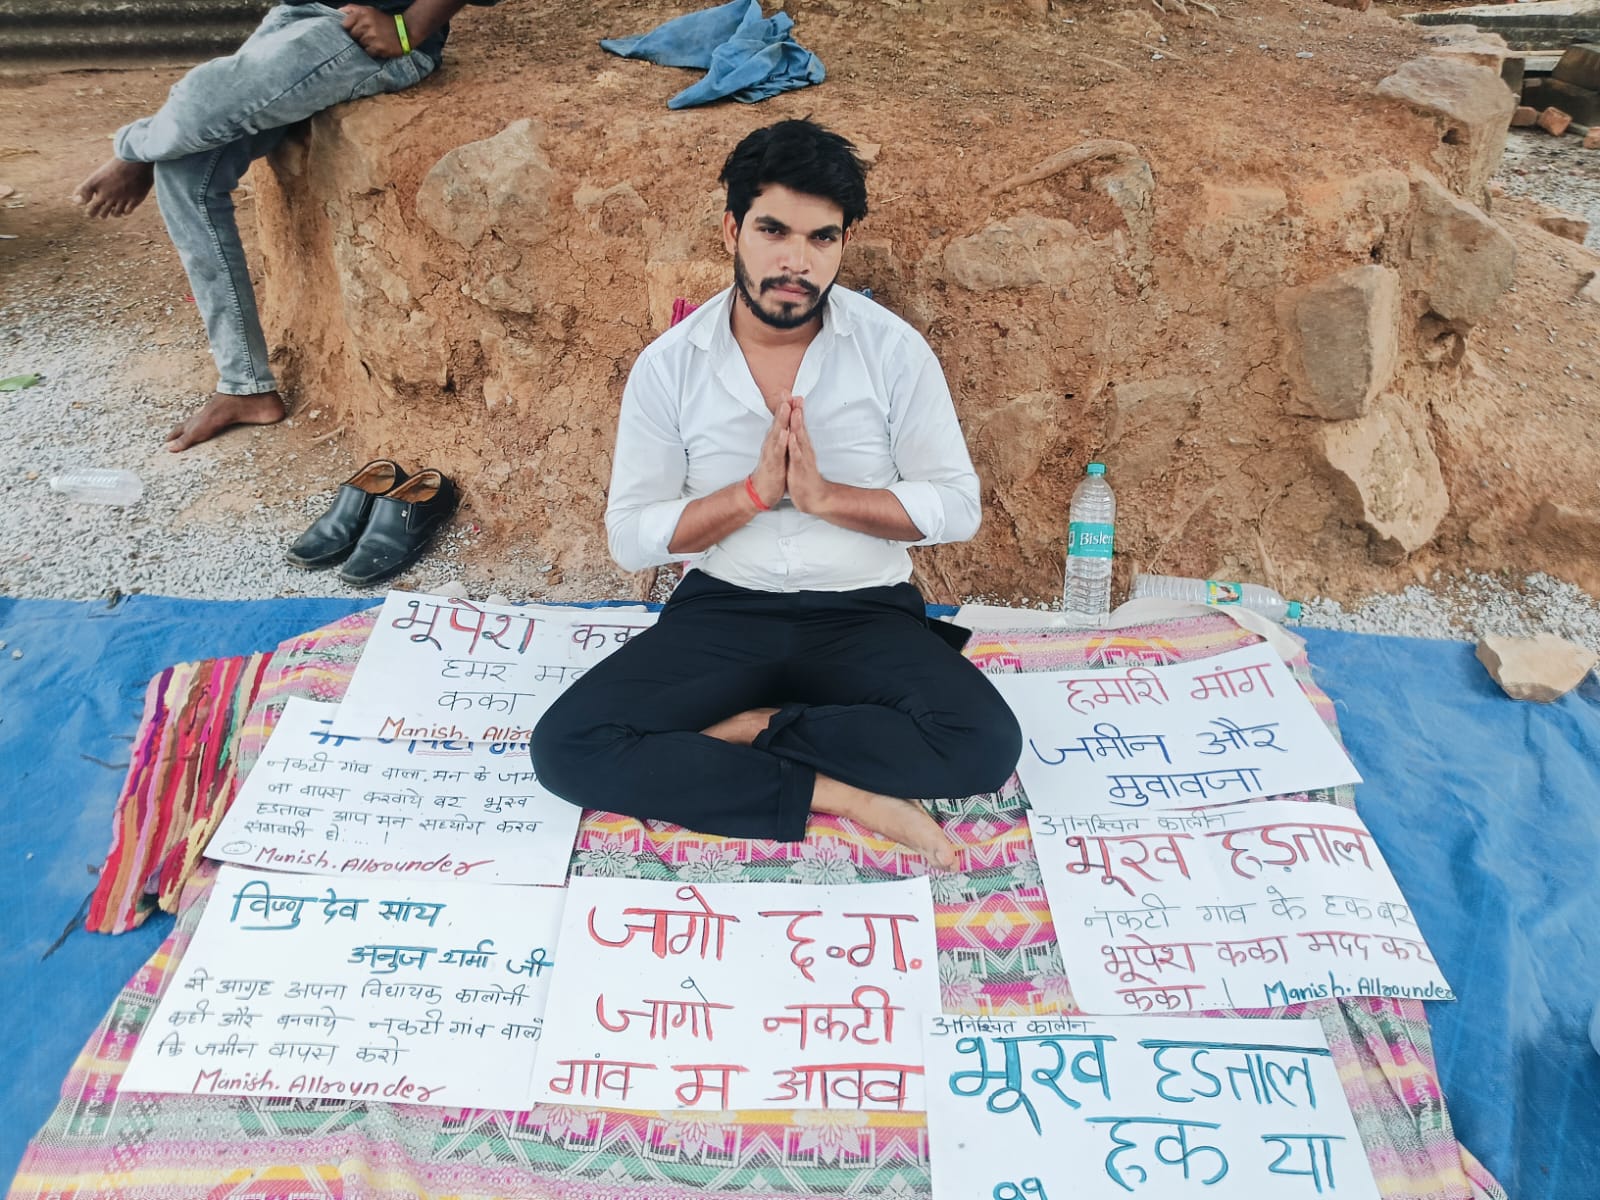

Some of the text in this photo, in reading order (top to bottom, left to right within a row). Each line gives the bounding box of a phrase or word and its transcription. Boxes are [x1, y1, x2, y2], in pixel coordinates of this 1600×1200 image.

[392, 597, 545, 655] भूपेश
[441, 659, 517, 682] हमर
[1057, 662, 1275, 715] हमारी मांग
[438, 691, 536, 715] कका
[1030, 717, 1288, 765] जमीन और
[432, 769, 469, 782] मन
[474, 765, 491, 782] के
[1106, 768, 1263, 807] मुवावजा
[332, 810, 372, 826] आप
[376, 815, 413, 829] मन
[496, 820, 543, 834] करव
[1066, 833, 1195, 897] भूख
[230, 880, 318, 930] विष्णु
[319, 888, 370, 925] देव
[1267, 885, 1307, 921] के
[1322, 894, 1373, 920] हक
[347, 939, 554, 978] अनुज शर्मा जी
[1101, 934, 1213, 985] भूपेश
[1216, 935, 1288, 967] कका
[1296, 931, 1371, 961] मदद
[284, 980, 348, 1001] अपना
[1114, 984, 1206, 1011] कका
[217, 1006, 263, 1029] और
[368, 1009, 445, 1035] नकटी
[449, 1016, 495, 1039] गांव
[596, 976, 905, 1050] जागो नकटी
[196, 1032, 259, 1058] जमीन
[268, 1042, 340, 1066] वापस
[548, 1053, 658, 1101] गांव
[671, 1064, 750, 1111] म
[949, 1035, 1117, 1136] भूख
[1085, 1117, 1347, 1194] हक या
